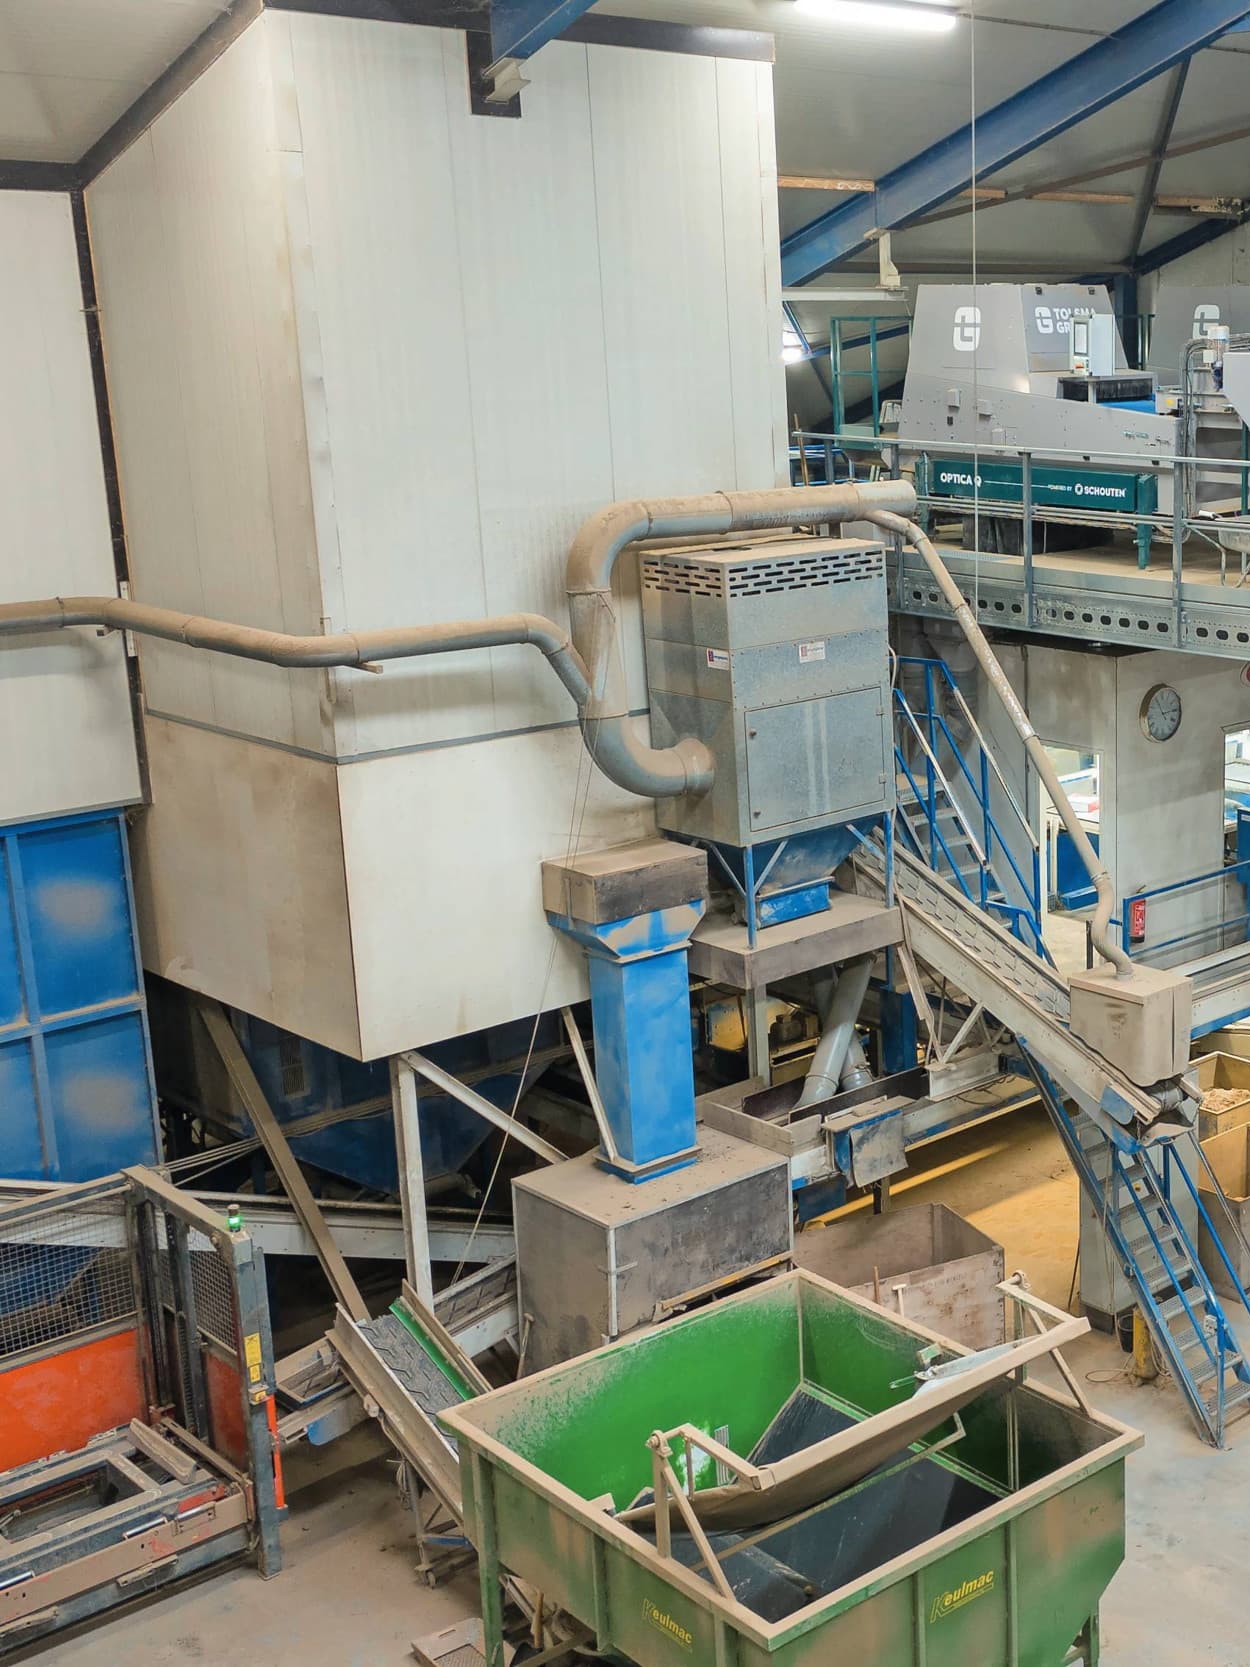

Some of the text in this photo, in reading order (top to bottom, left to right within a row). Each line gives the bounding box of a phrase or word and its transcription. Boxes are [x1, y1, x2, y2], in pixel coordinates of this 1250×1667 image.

[940, 472, 973, 486] OPTICA
[1084, 486, 1126, 498] SCHOUTEN
[929, 1570, 994, 1625] Keulmac
[641, 1598, 693, 1645] Keulmac
